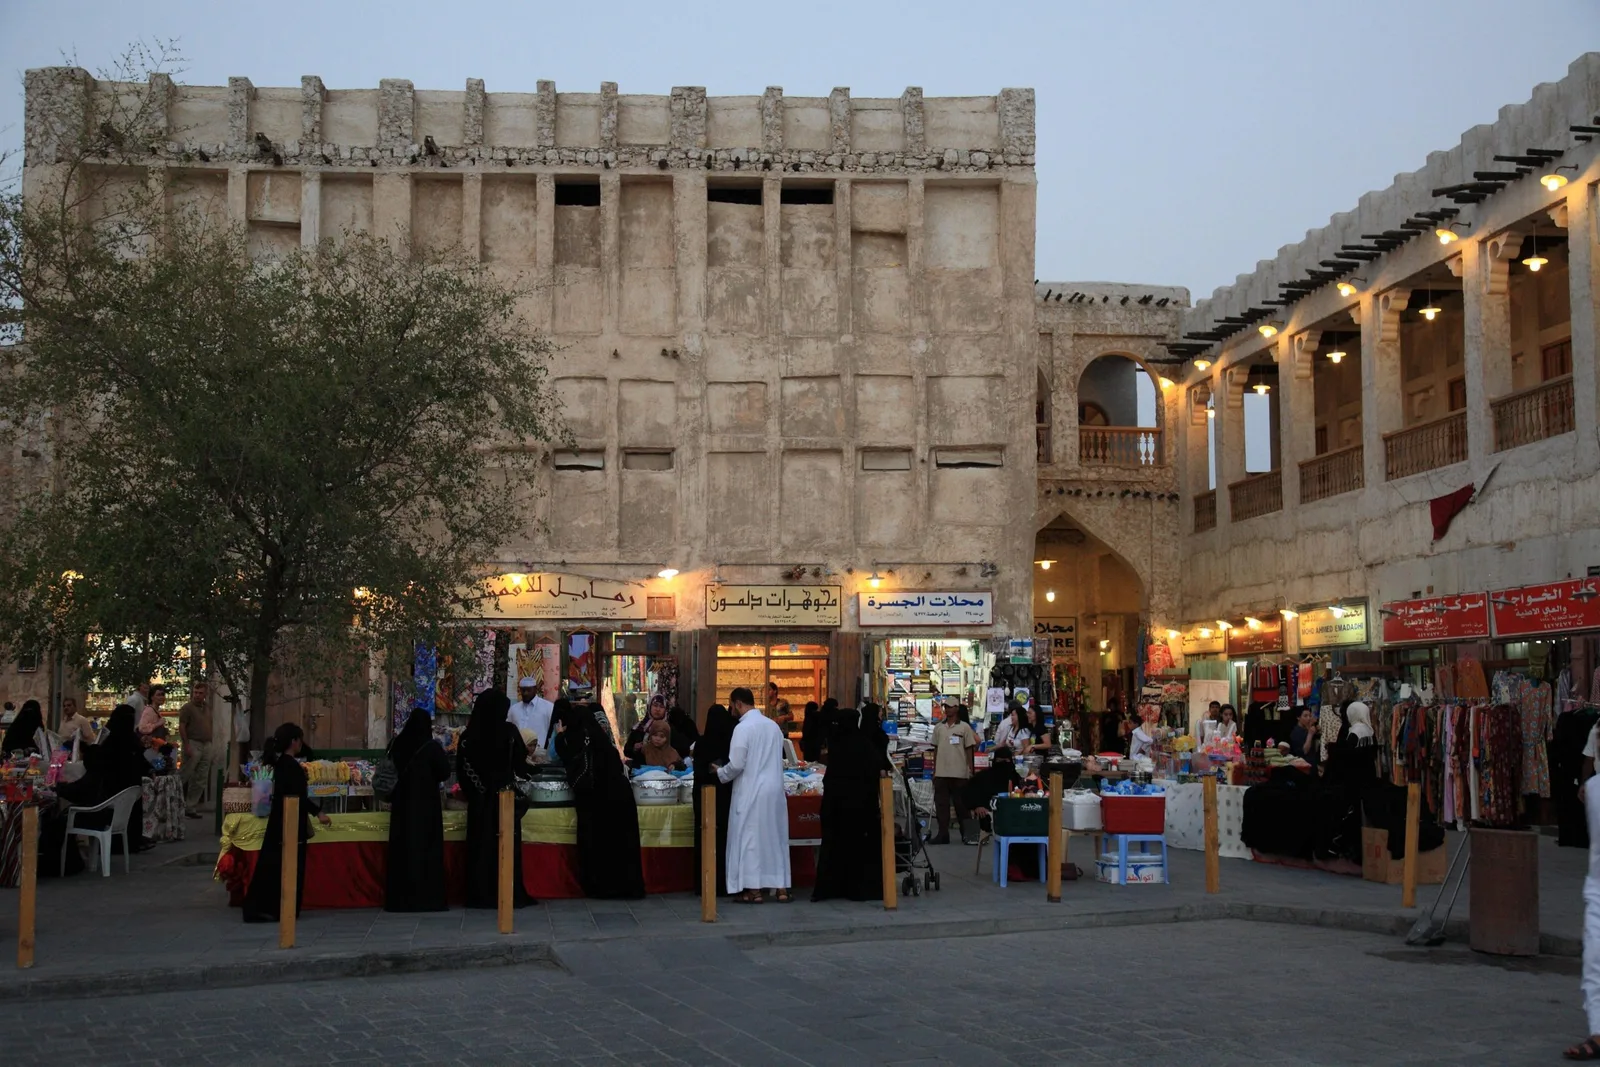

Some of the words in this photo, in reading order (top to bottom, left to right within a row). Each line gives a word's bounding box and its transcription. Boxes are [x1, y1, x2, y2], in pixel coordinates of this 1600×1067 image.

[709, 589, 762, 612] دلمون
[766, 589, 838, 612] مجوهرات
[867, 595, 925, 610] الجسرة
[929, 595, 984, 607] محلات
[1511, 588, 1562, 606] الخواج
[1396, 602, 1438, 619] الخواج
[1034, 622, 1074, 634] محلا
